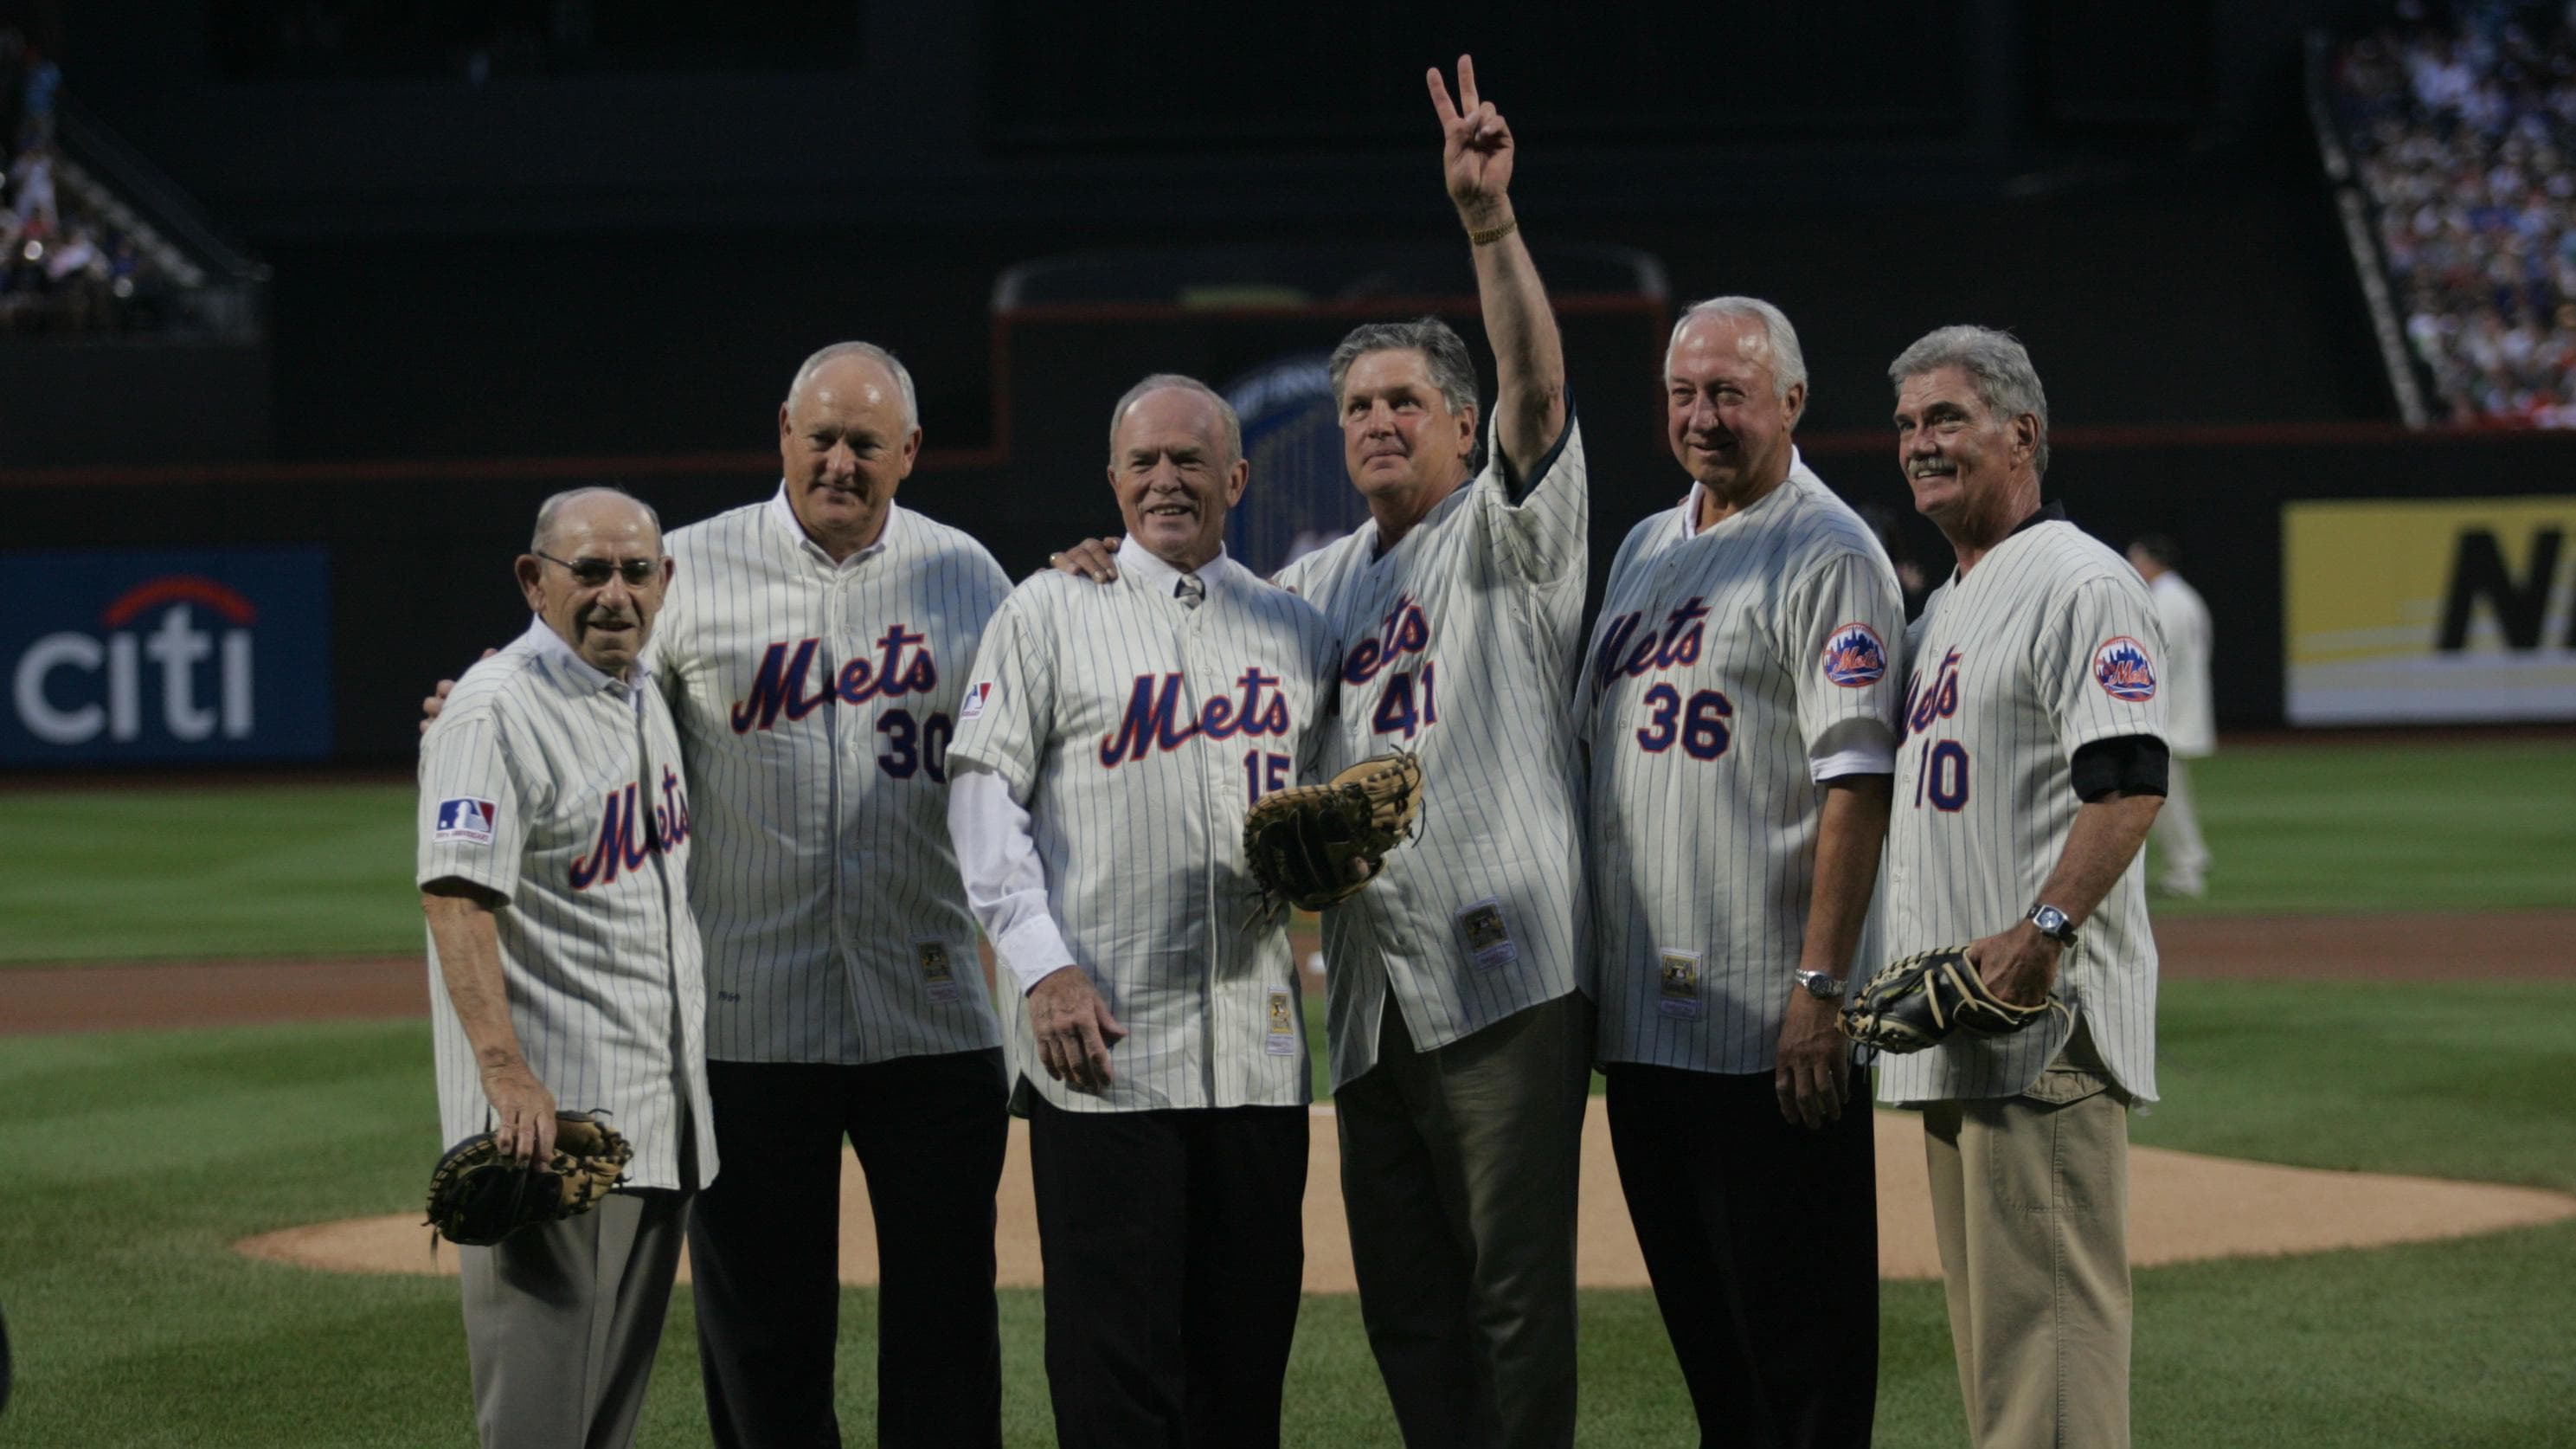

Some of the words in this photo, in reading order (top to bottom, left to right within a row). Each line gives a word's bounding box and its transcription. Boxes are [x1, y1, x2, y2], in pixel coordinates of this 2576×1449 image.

[1339, 589, 1429, 686] ets
[2435, 526, 2576, 654] N
[12, 602, 255, 746] citi
[731, 624, 936, 734] Mets
[1099, 667, 1291, 769] Mets
[1372, 661, 1437, 741] 41
[1637, 681, 1733, 762] 36
[877, 708, 954, 784] 30
[1243, 749, 1291, 810] 15
[1914, 737, 1969, 813] 10
[569, 763, 691, 891] Mets
